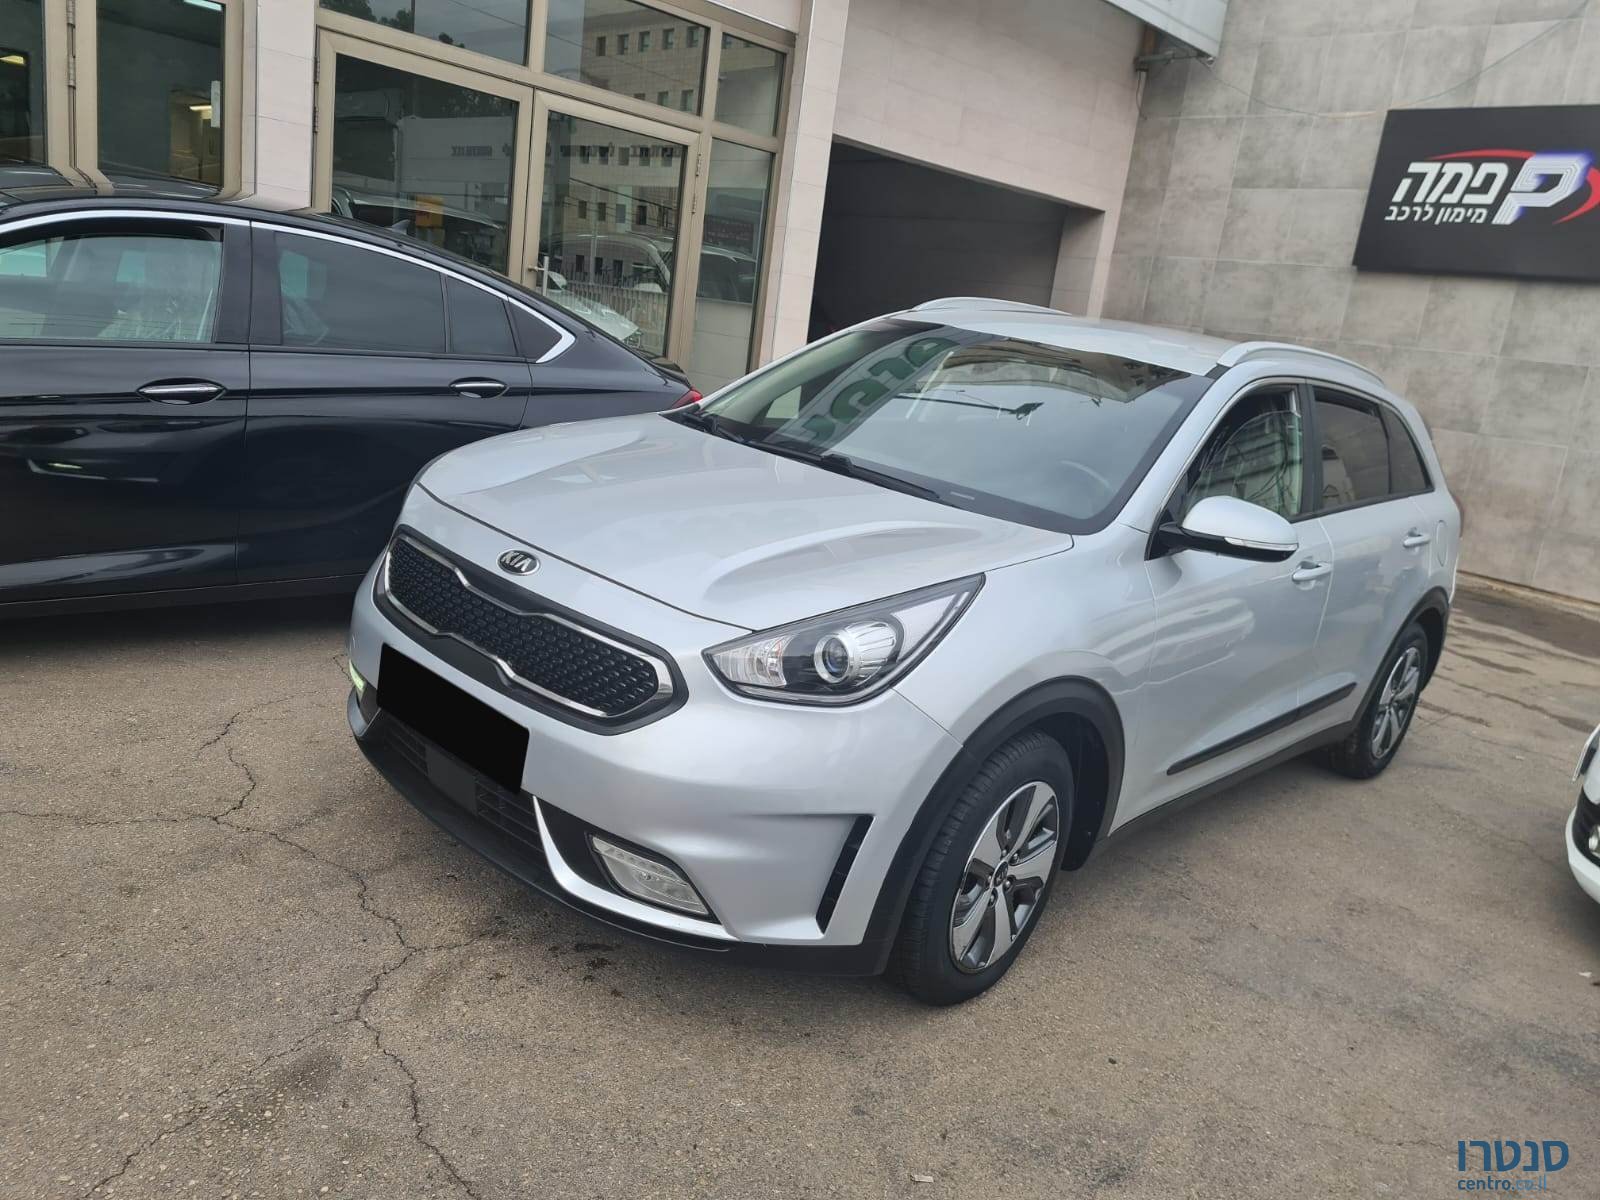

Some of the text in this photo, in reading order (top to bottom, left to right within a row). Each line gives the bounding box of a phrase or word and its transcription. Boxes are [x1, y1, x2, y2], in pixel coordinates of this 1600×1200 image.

[1391, 162, 1509, 205] פמה
[1384, 204, 1488, 226] מימון לרכב
[500, 551, 533, 572] KIA
